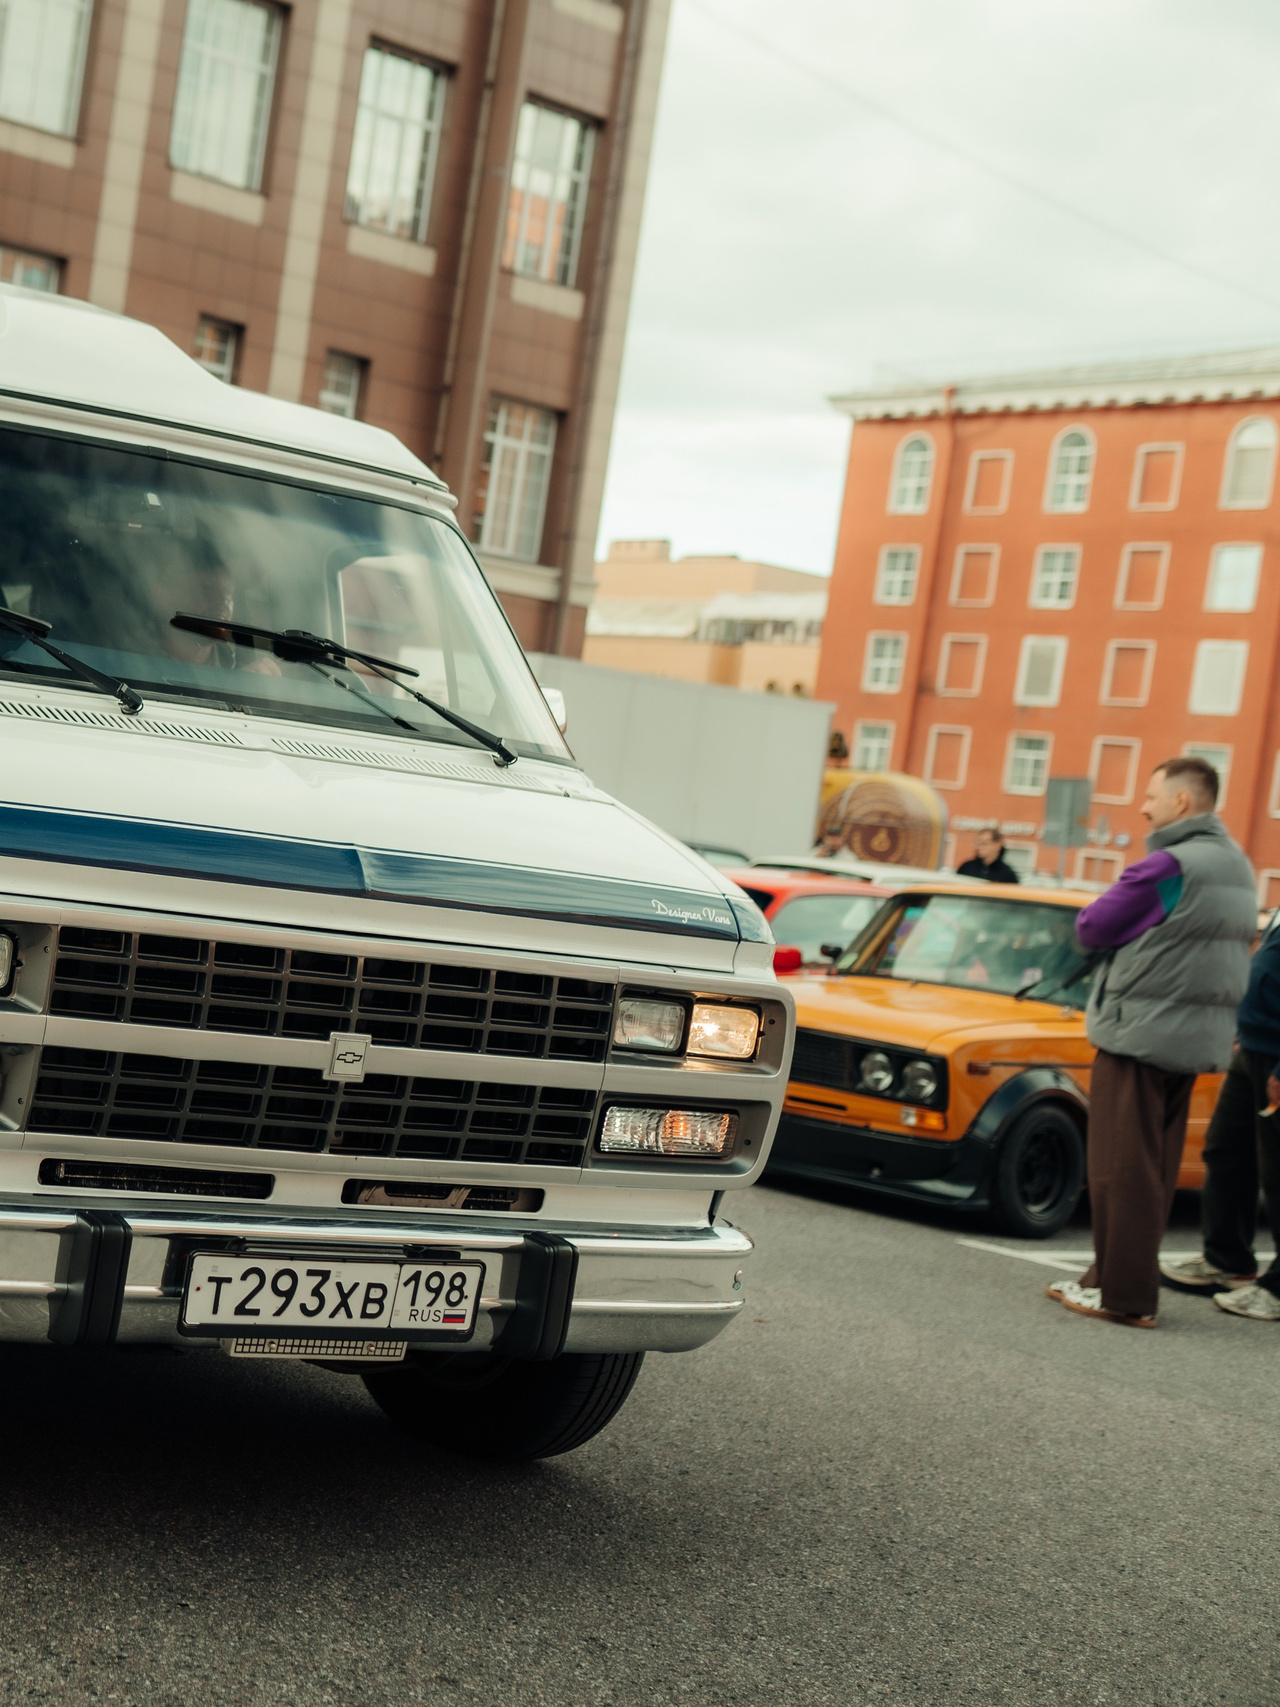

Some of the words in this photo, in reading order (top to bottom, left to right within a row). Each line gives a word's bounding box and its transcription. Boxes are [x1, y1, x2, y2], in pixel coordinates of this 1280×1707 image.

[651, 899, 702, 925] Designer
[703, 907, 732, 925] Vans
[403, 1270, 467, 1307] 198
[408, 1309, 441, 1323] RUS
